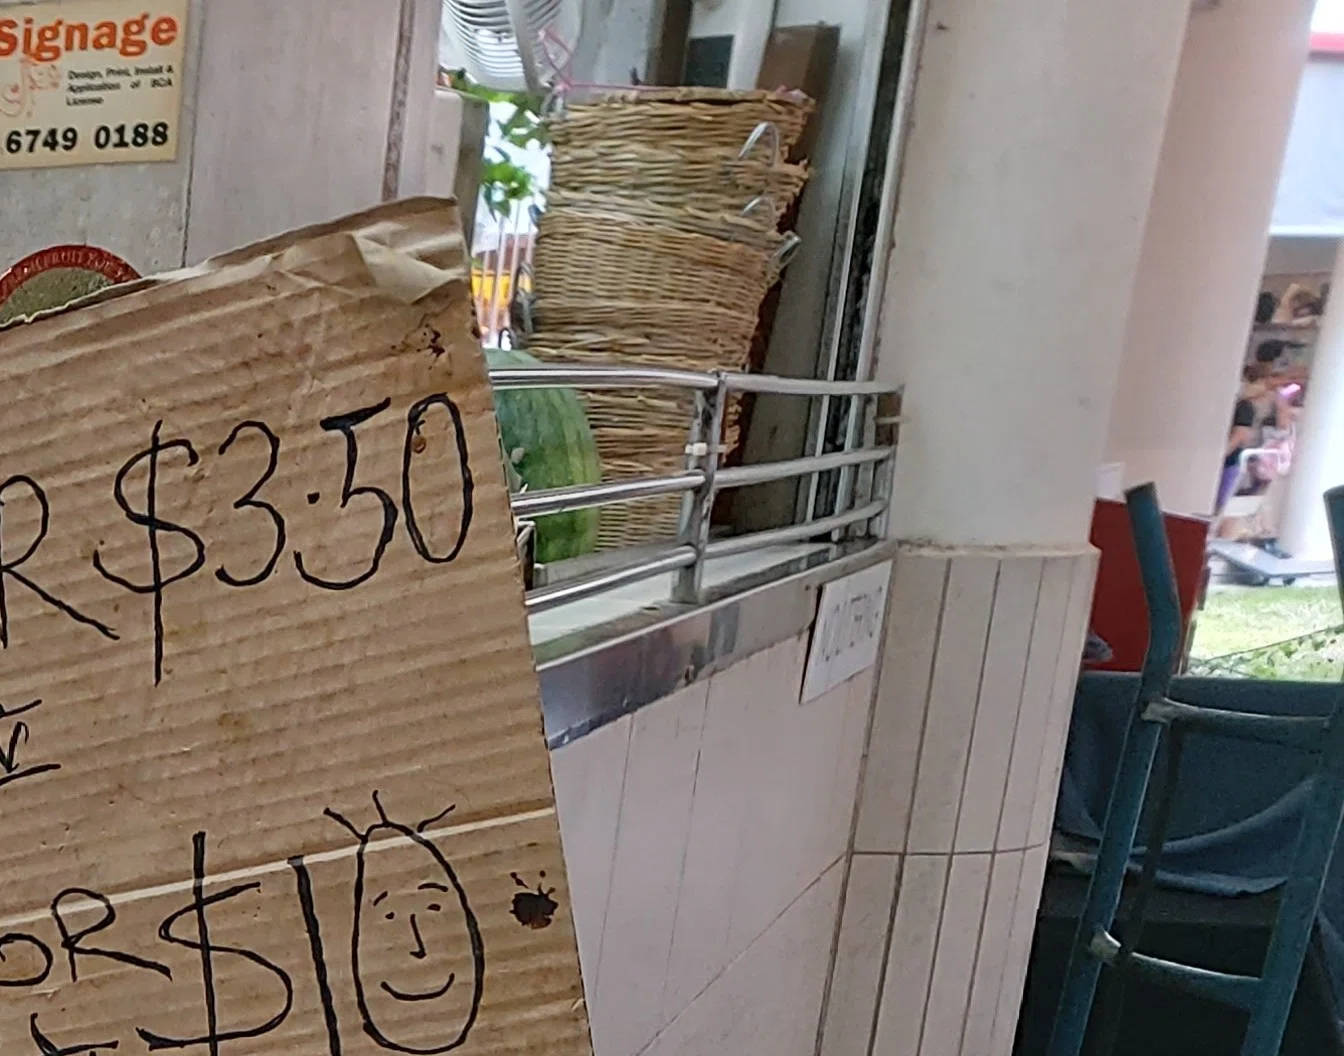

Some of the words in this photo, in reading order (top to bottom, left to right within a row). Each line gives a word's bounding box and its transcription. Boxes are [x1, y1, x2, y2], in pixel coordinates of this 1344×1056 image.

[6, 127, 78, 154] 6749
[94, 122, 169, 149] 0188
[92, 392, 474, 686] $3.50
